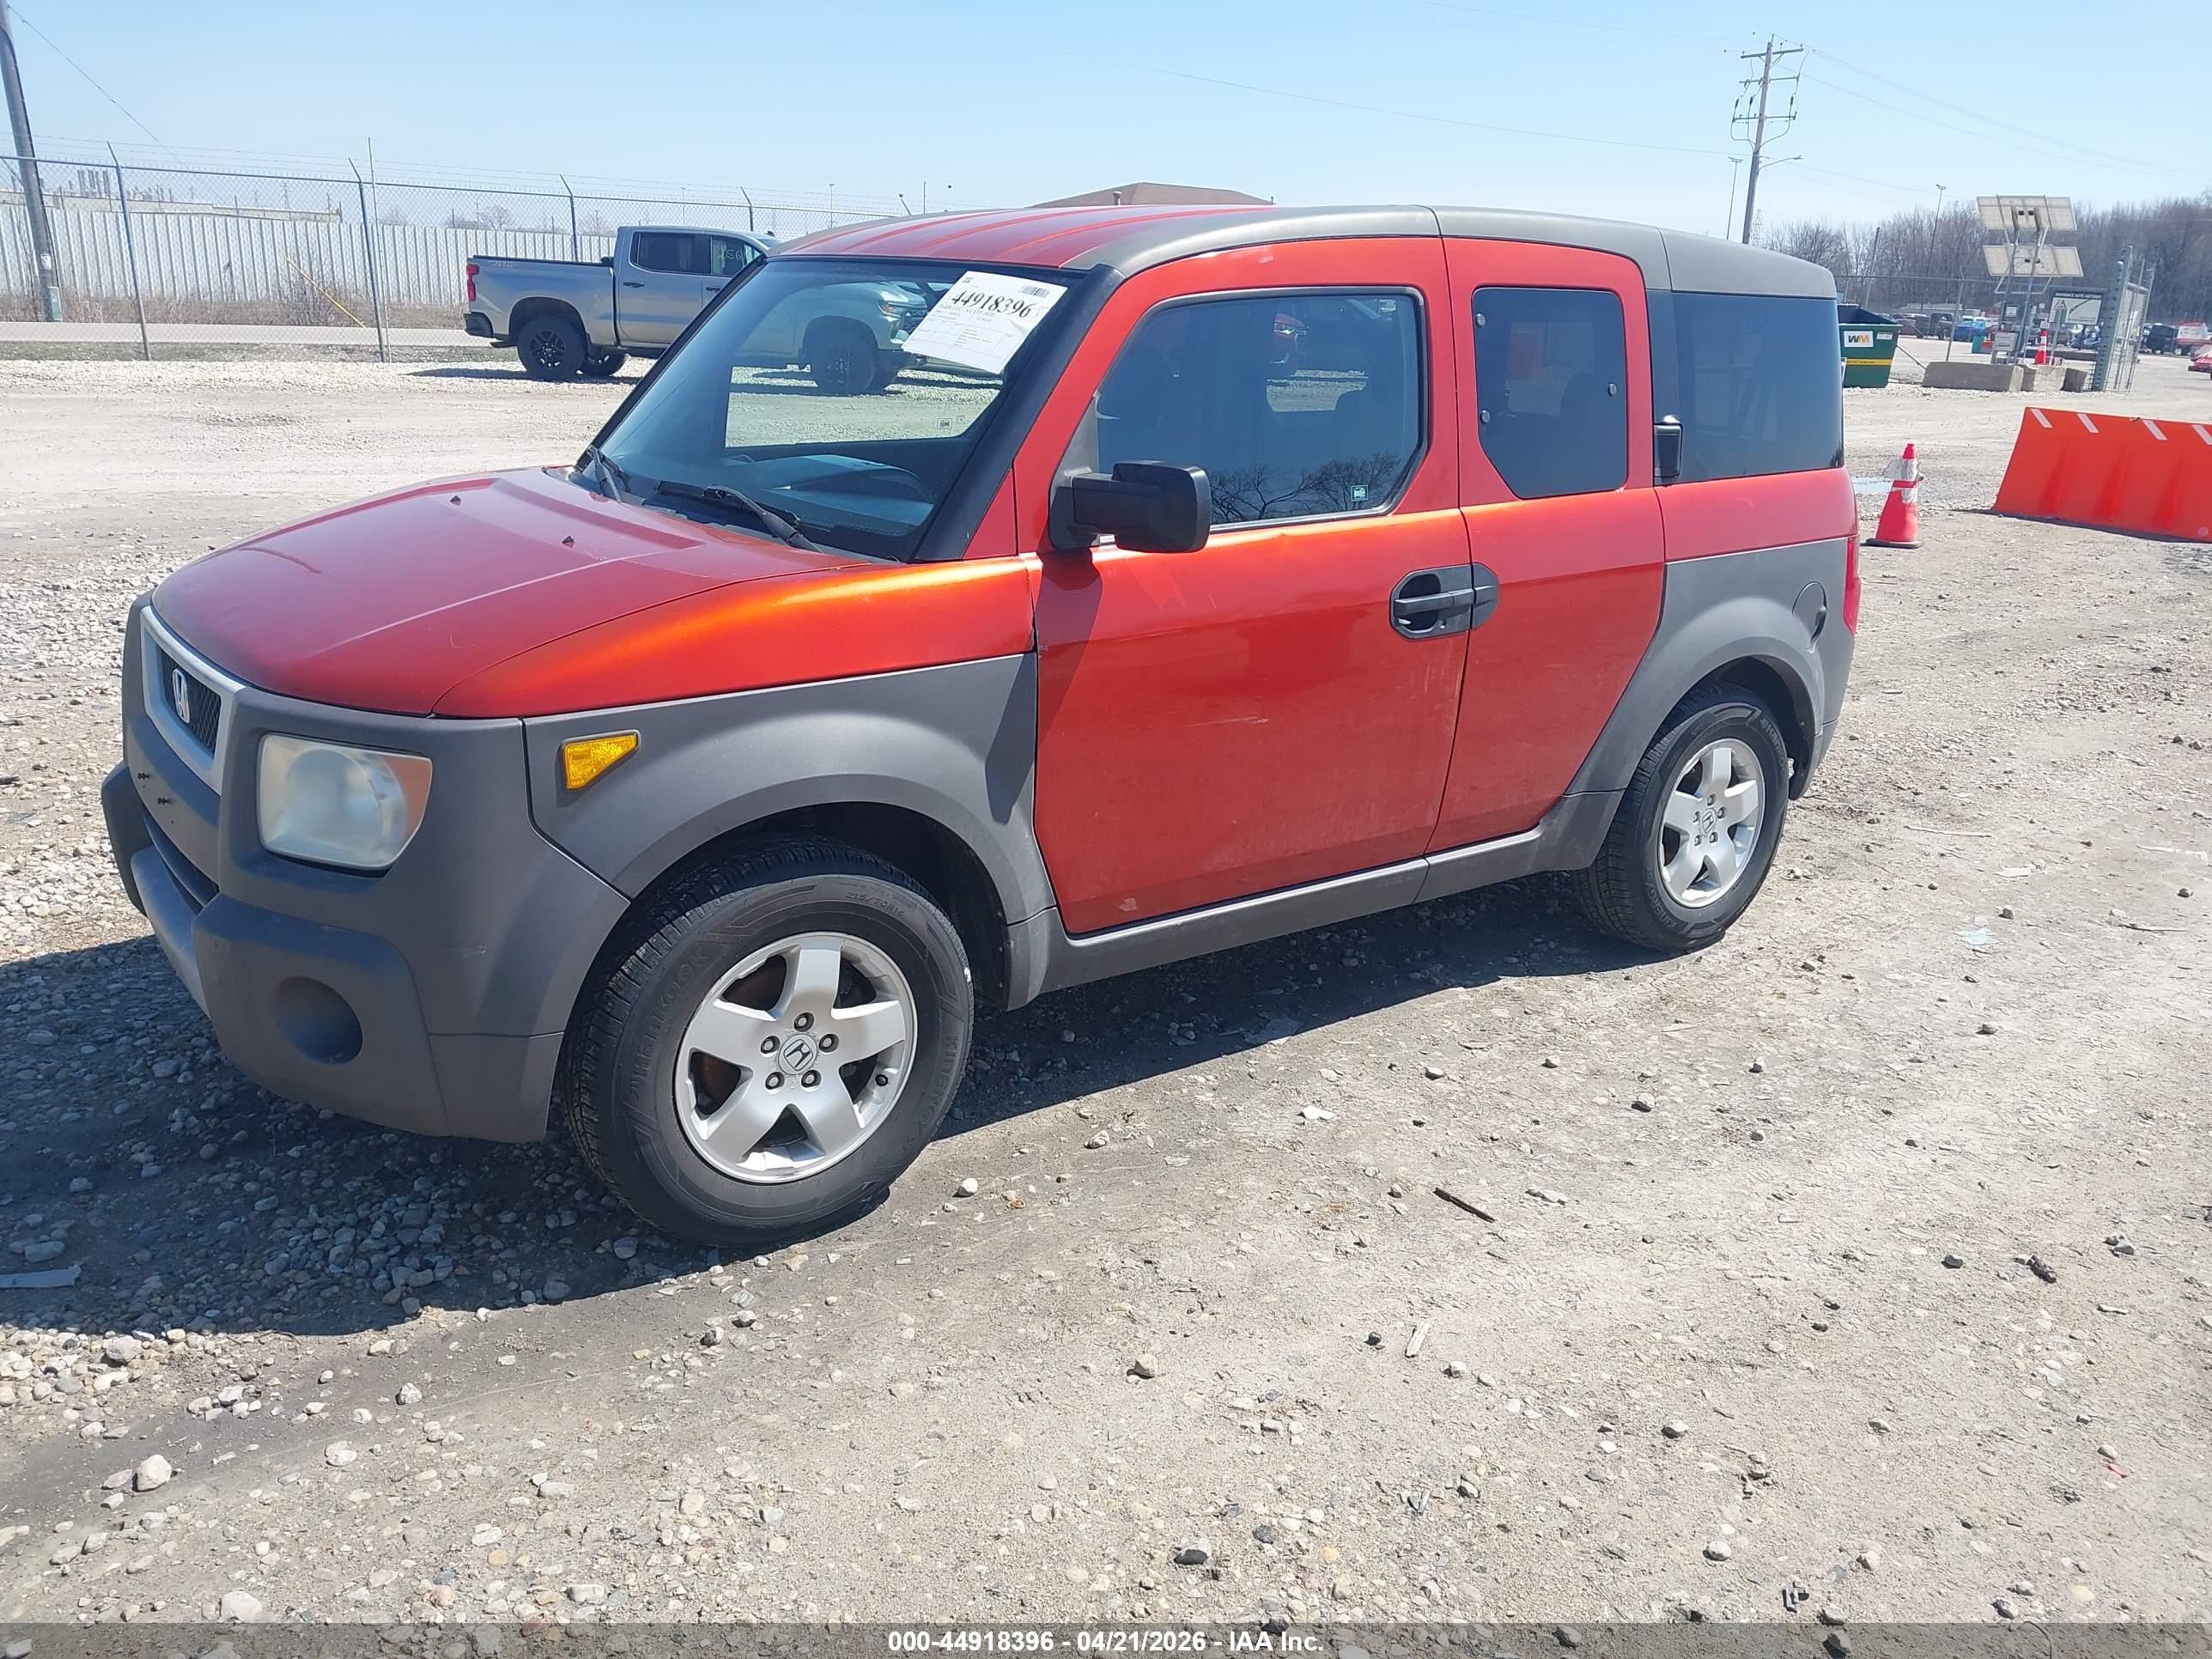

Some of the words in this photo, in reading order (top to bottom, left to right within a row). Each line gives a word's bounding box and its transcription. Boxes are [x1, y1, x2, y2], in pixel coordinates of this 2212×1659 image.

[951, 290, 1037, 318] 44918396
[1848, 335, 1869, 343] WM
[845, 892, 907, 917] 215/70R16
